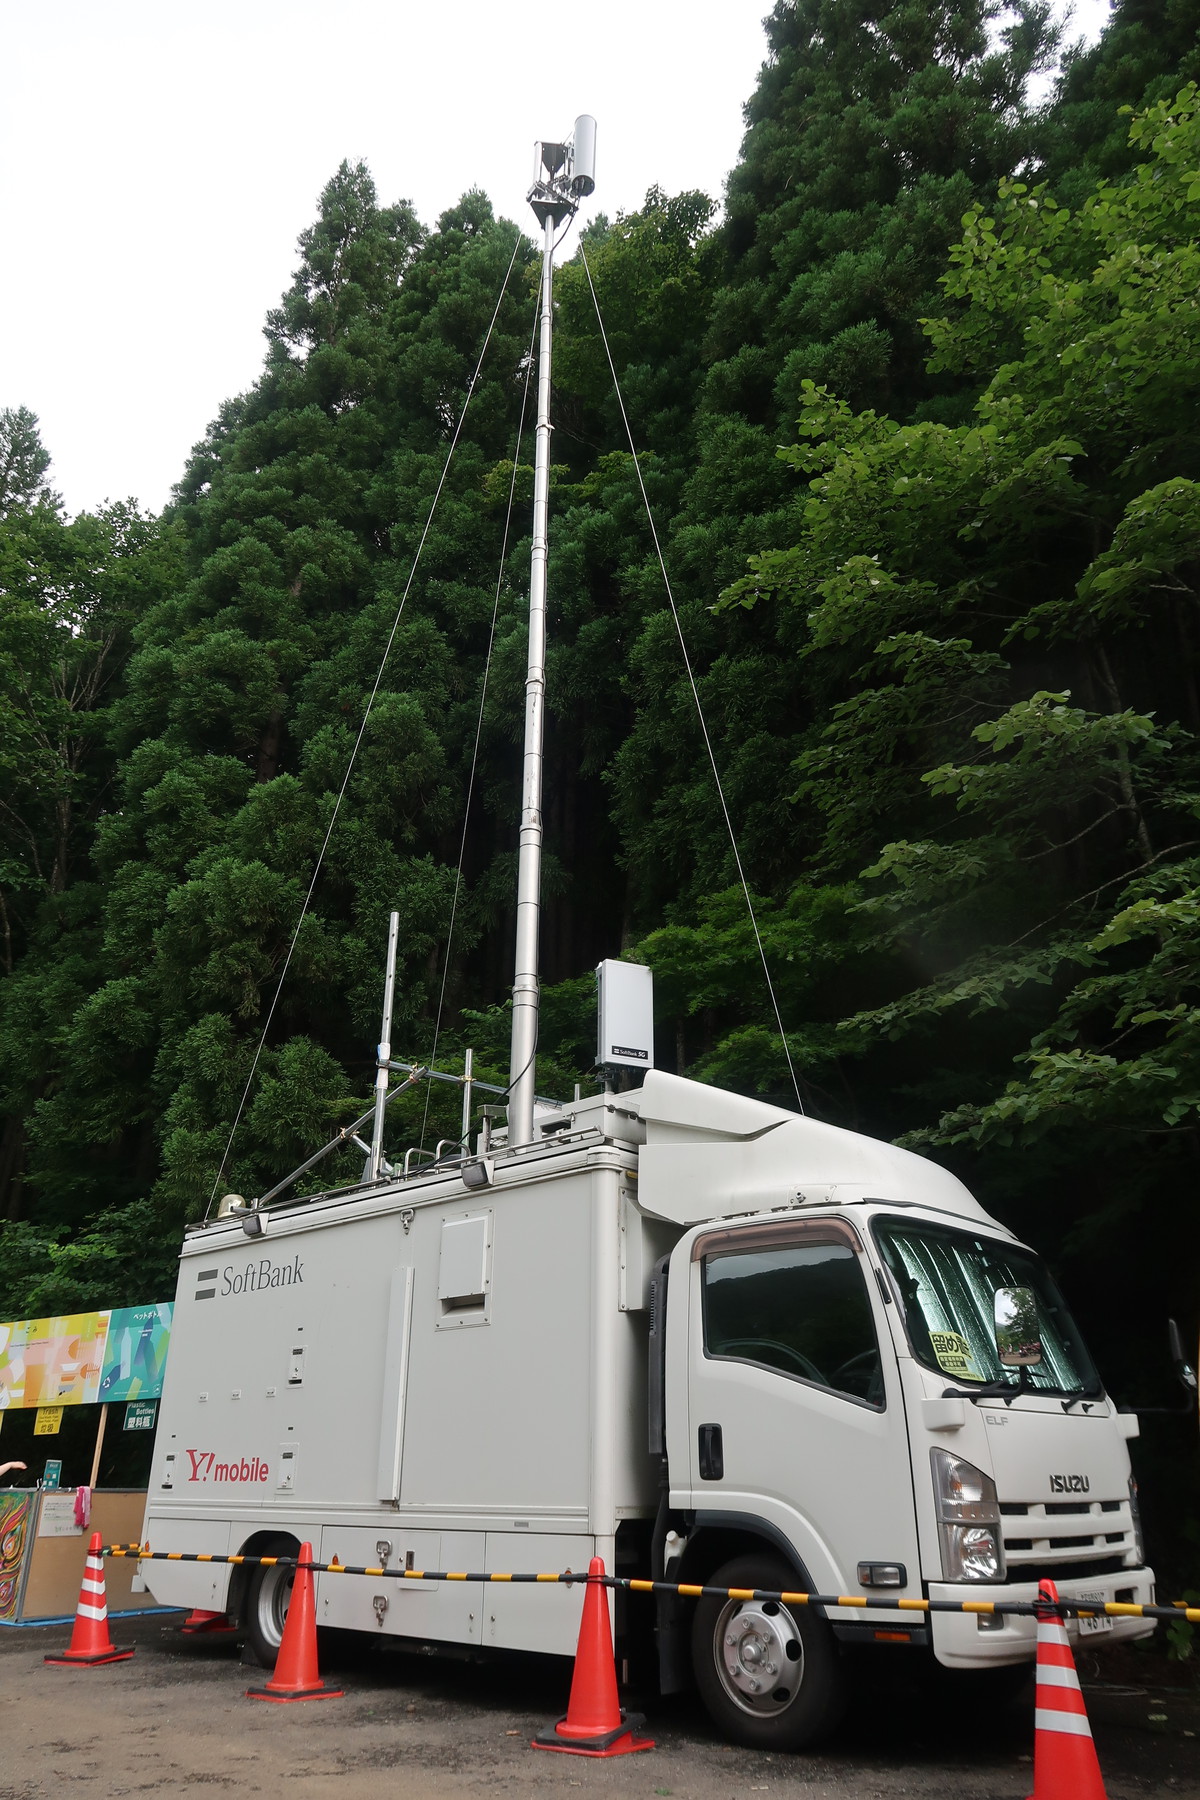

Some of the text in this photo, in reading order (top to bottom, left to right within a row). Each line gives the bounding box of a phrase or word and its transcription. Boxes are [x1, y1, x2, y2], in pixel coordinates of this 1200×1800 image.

[220, 1255, 304, 1296] SoftBank
[985, 1415, 1008, 1426] ELF
[1049, 1475, 1090, 1493] ISUZU
